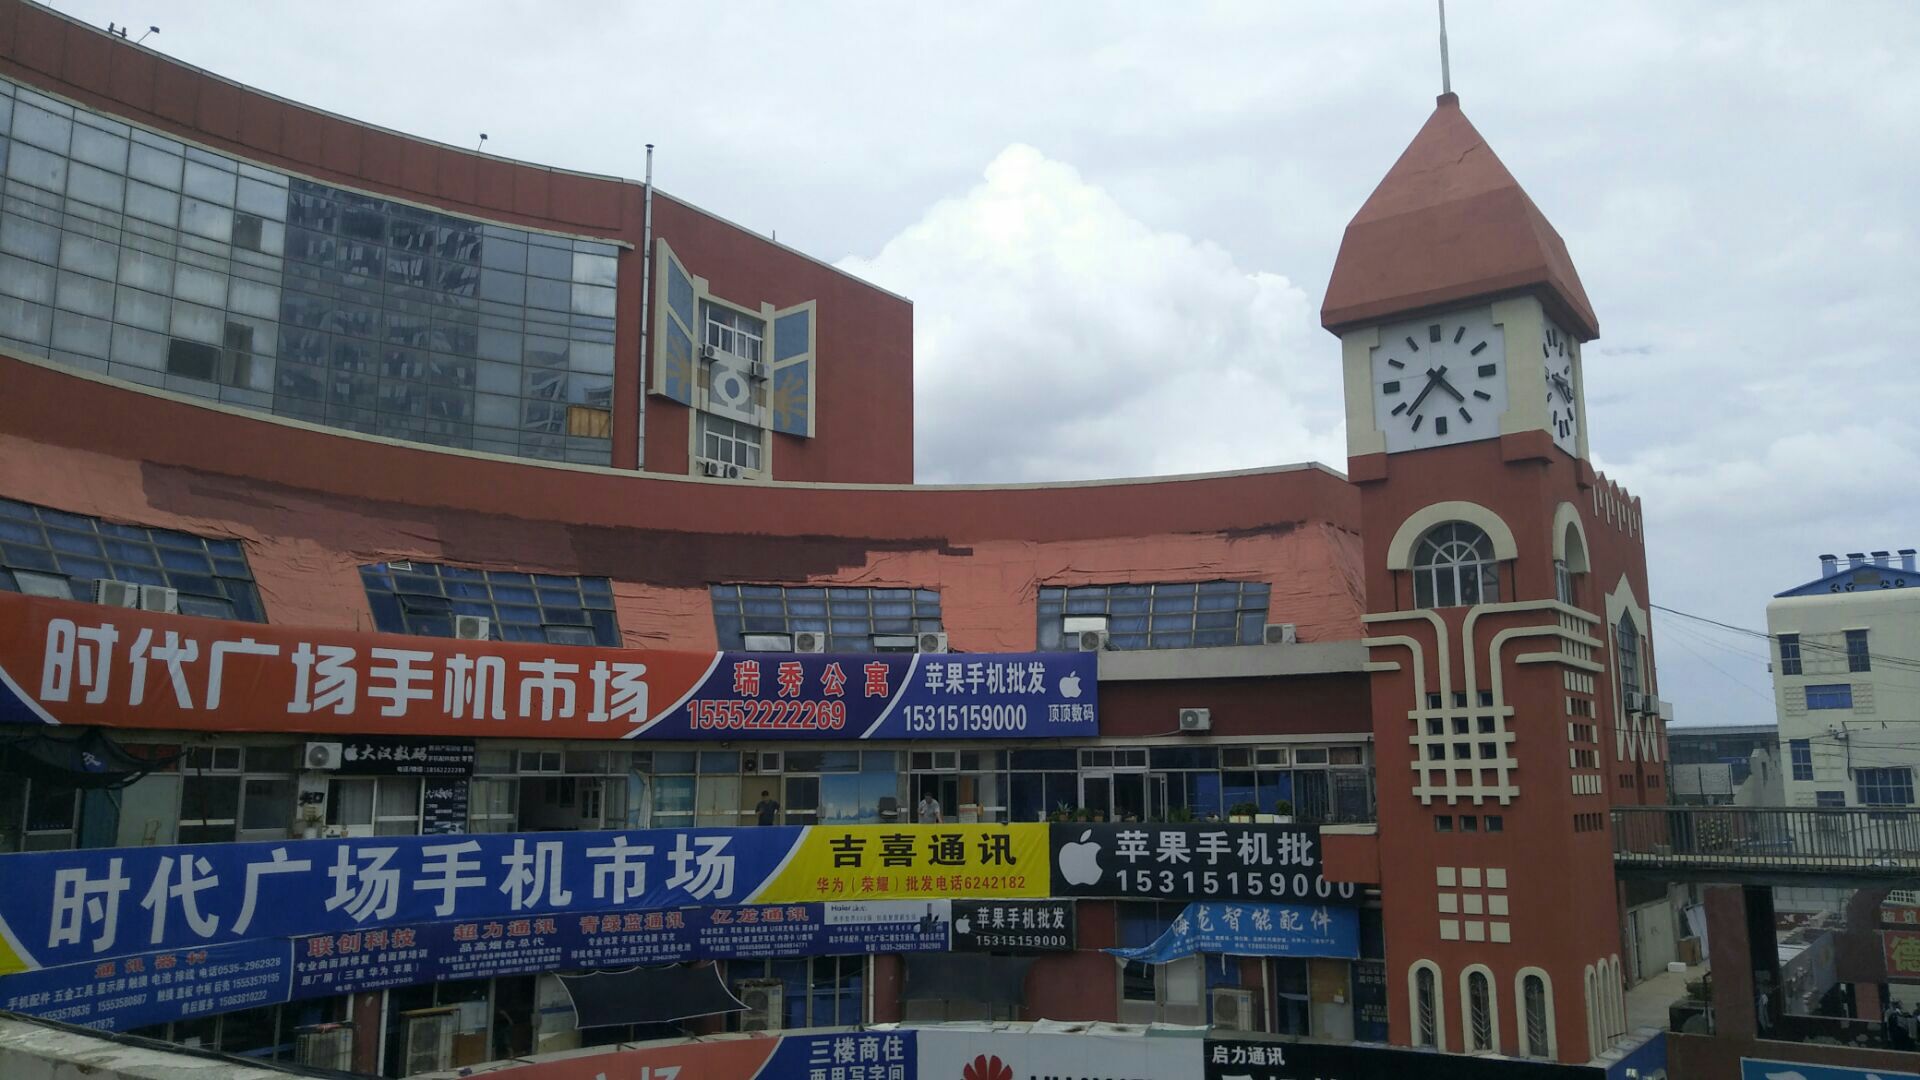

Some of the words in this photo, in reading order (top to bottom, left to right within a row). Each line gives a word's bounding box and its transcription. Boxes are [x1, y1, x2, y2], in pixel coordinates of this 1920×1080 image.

[40, 618, 649, 723] 时代广场手机市场
[733, 661, 890, 698] 瑞秀公寓
[925, 662, 1046, 695] 苹果手机批发
[686, 700, 846, 730] 15552222269
[903, 704, 1027, 732] 15315159000
[1048, 704, 1094, 723] 顶顶数码
[360, 744, 427, 761] 大汉数码
[830, 833, 1017, 868] 吉喜通讯
[1115, 830, 1324, 867] 苹果手机批
[47, 834, 739, 950] 时代广场手机市场
[1115, 870, 1355, 899] 15315159000
[453, 918, 557, 941] 超力通讯
[579, 911, 685, 934] 青绿蓝通讯
[710, 906, 809, 924] 亿龙通讯
[977, 907, 1065, 929] 苹果手机批发
[307, 928, 416, 957] 联创科技
[976, 935, 1066, 946] 15315159000
[809, 1035, 904, 1064] 三楼商住
[1212, 1045, 1285, 1065] 启力通讯
